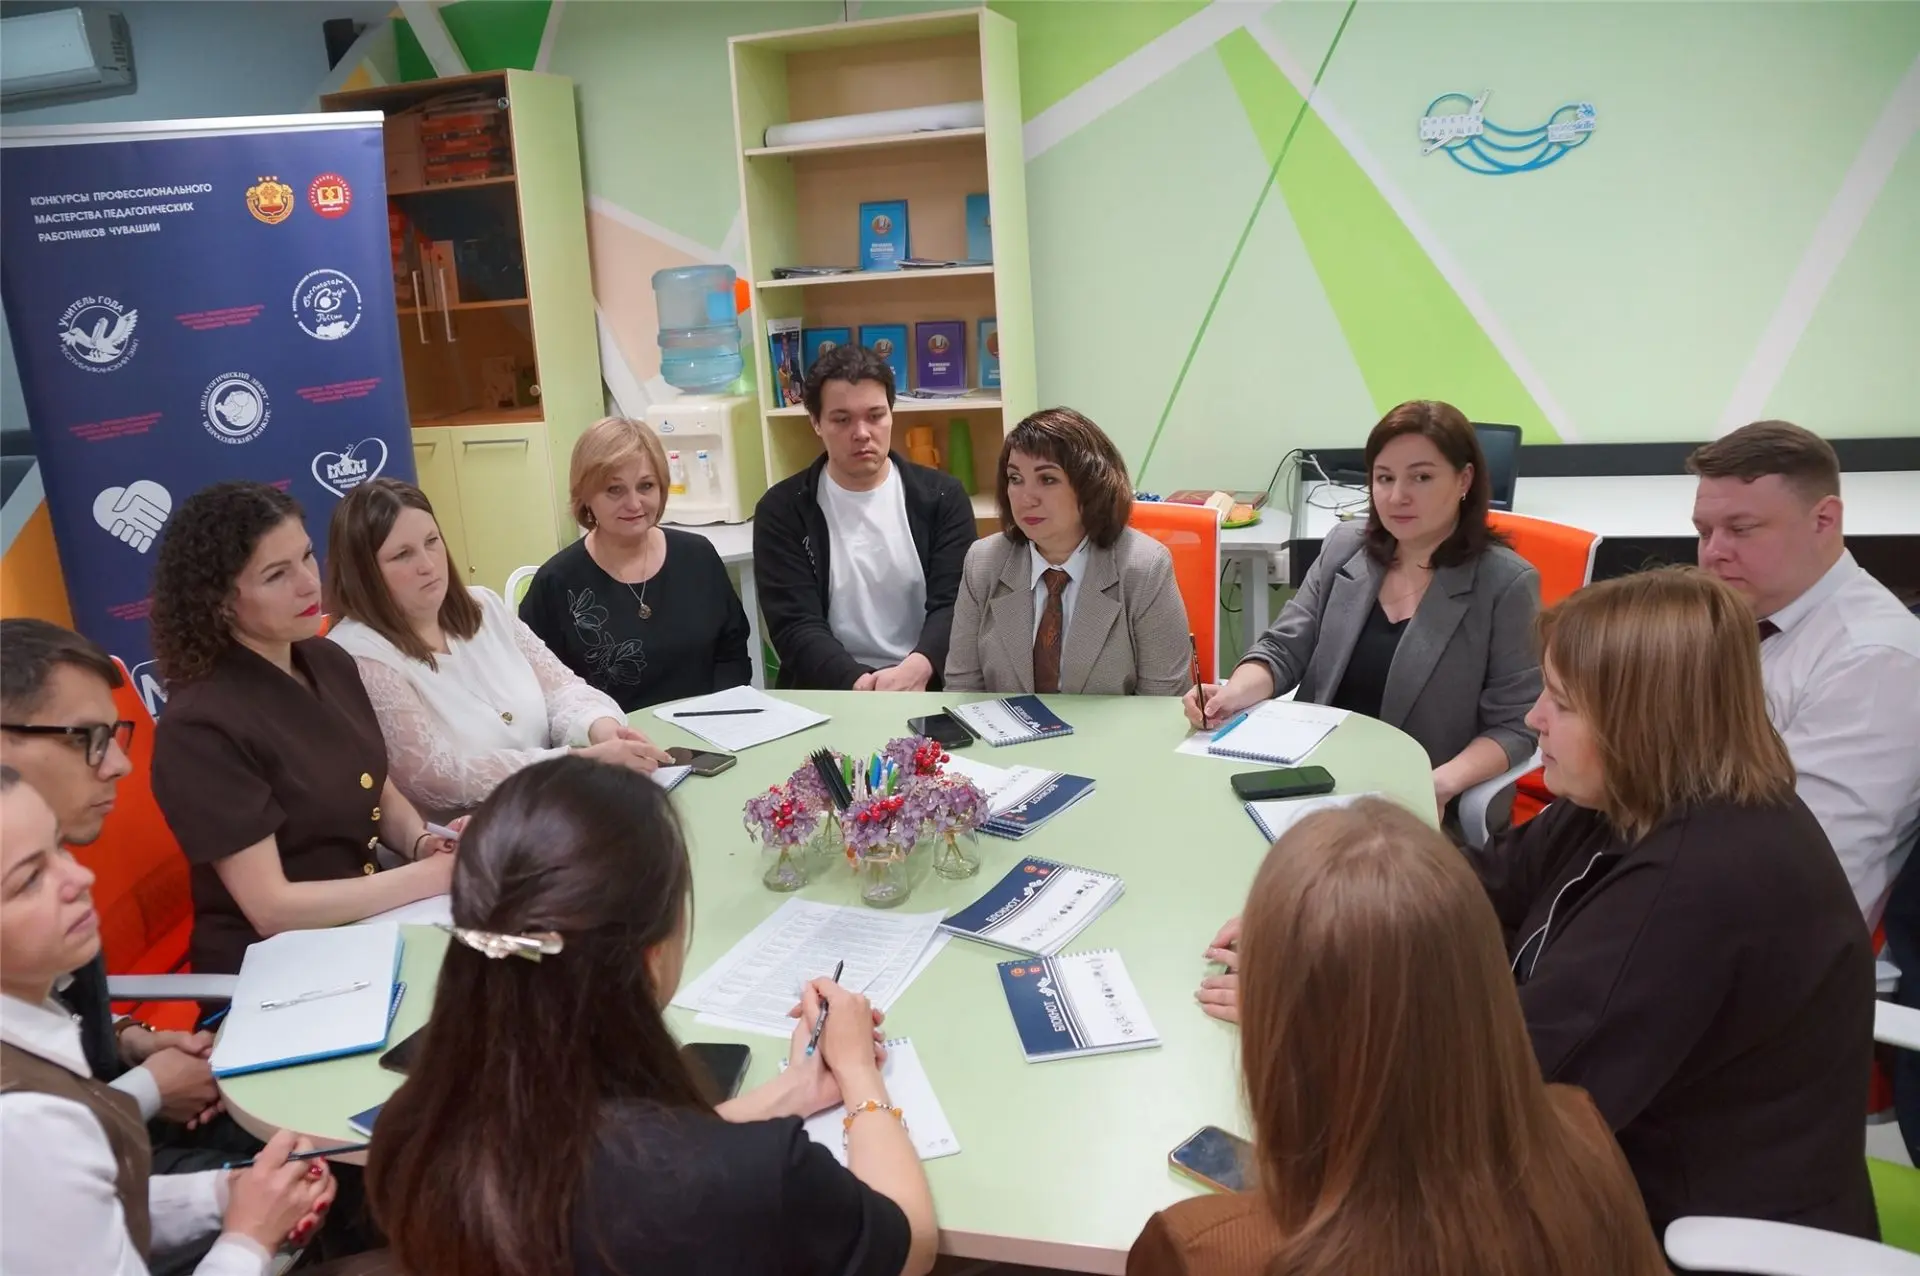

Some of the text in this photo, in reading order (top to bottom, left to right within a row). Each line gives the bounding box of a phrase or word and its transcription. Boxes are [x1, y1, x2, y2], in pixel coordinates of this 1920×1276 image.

[30, 183, 212, 206] КОНКУРСЫ ПРОФЕССИОНАЛЬНОГО
[34, 202, 194, 224] МАСТЕРСТВА ПЕДАГОГИЧЕСКИХ
[38, 223, 161, 242] РАБОТНИКОВ ЧУВАШИИ
[58, 295, 124, 328] УЧИТЕЛЬ ГОДА
[200, 371, 250, 410] ПЕДАГОГИЧЕСКИЙ
[250, 377, 269, 399] ДЕБЮТ
[202, 409, 272, 444] ВСЕРОССИЙСКИЙ КОНКУРС
[985, 896, 1022, 924] БЛОКНОТ
[1043, 1001, 1066, 1033] БЛОКНОТ
